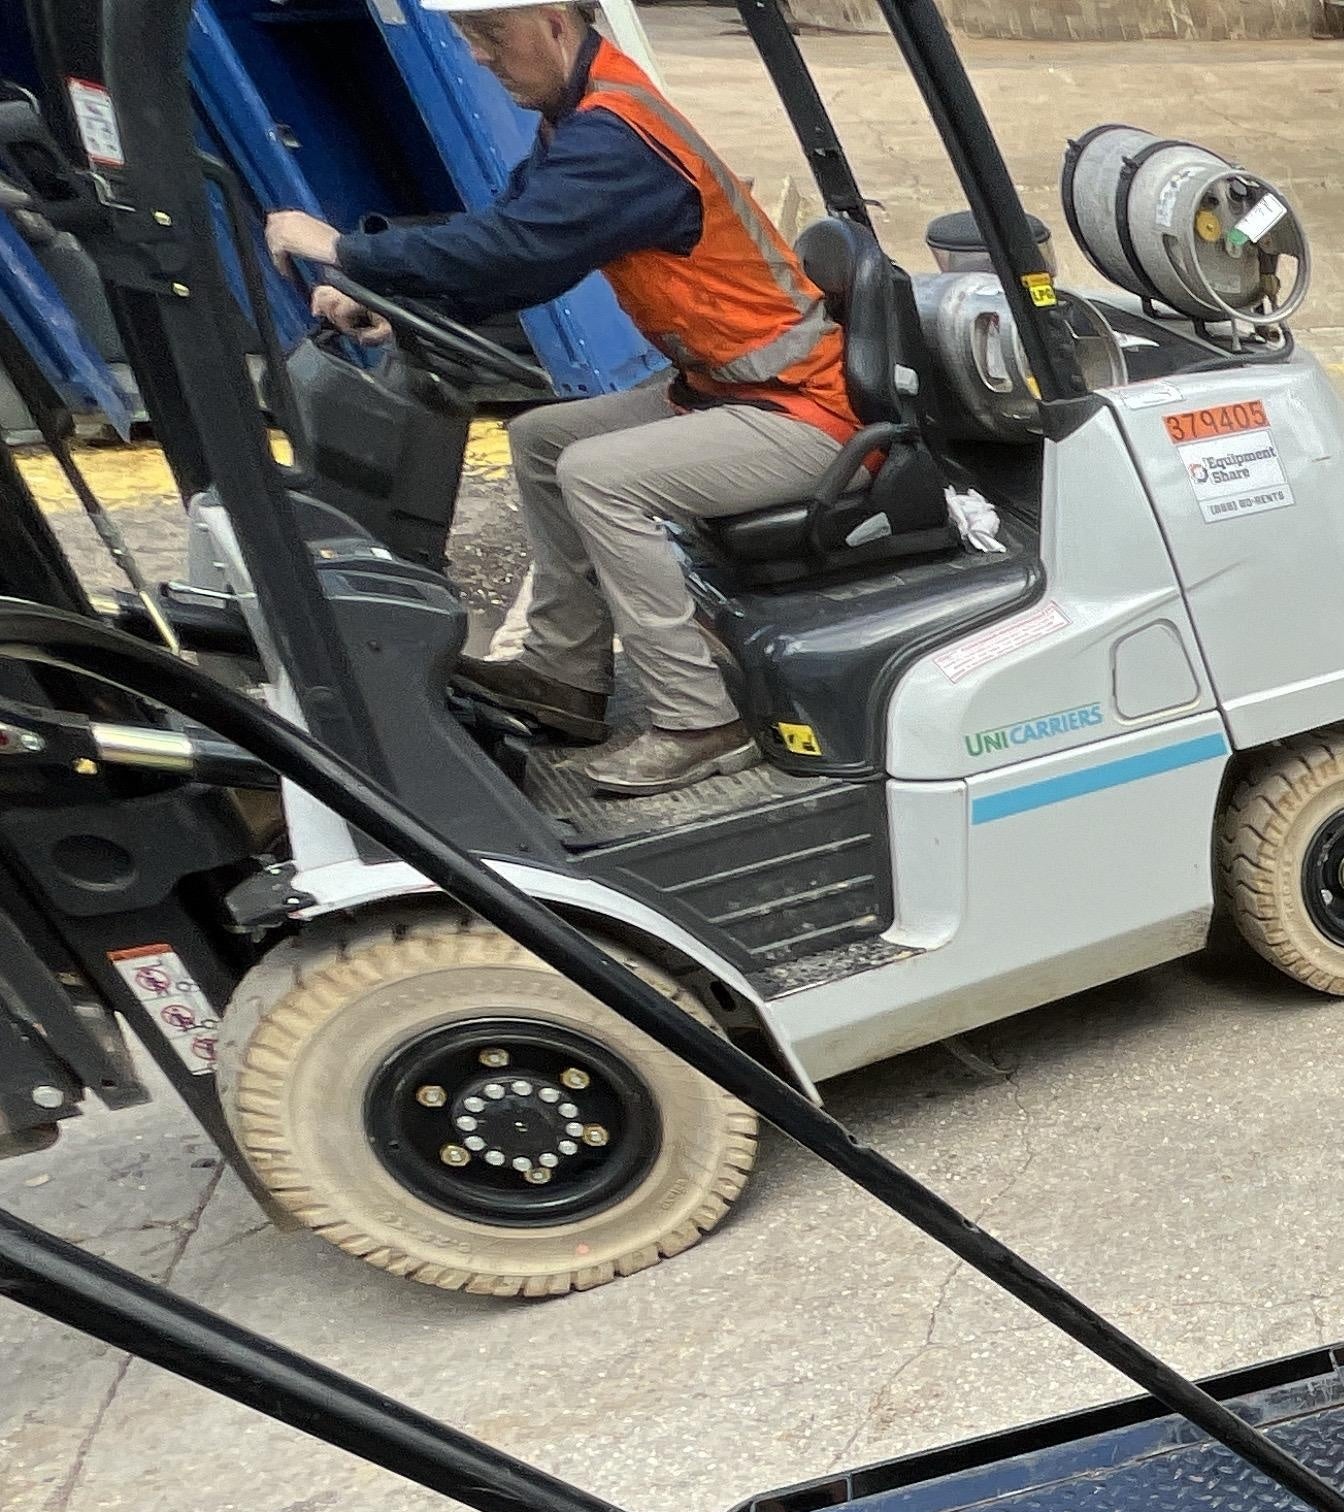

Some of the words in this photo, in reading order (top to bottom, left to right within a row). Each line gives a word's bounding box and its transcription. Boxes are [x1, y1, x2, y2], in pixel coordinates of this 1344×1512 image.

[1166, 400, 1268, 441] 379405
[1207, 446, 1277, 469] Equipment
[1211, 467, 1251, 484] Share
